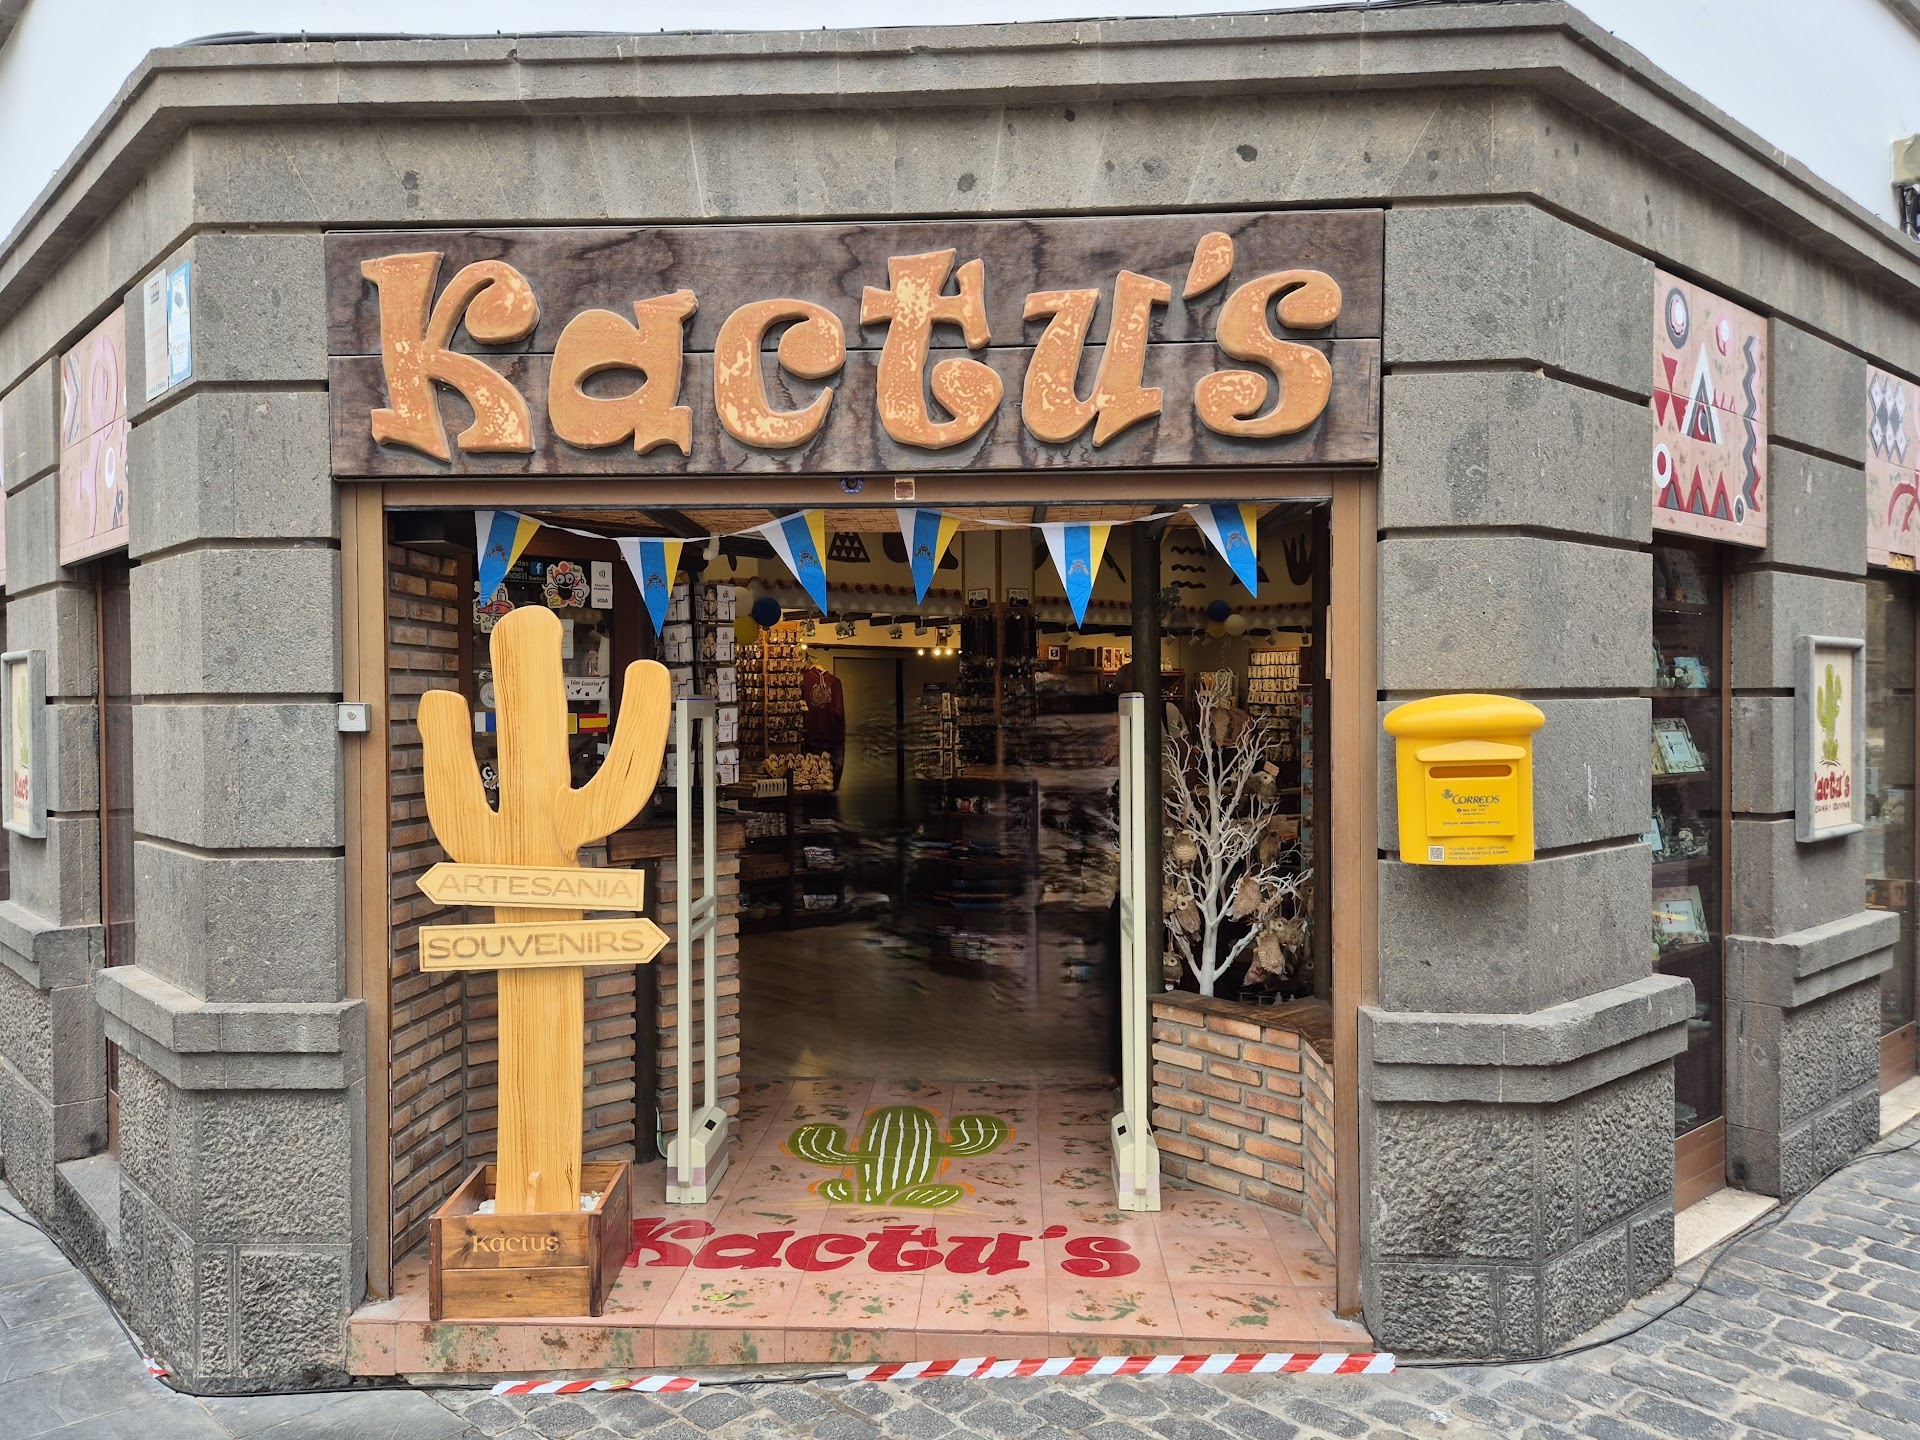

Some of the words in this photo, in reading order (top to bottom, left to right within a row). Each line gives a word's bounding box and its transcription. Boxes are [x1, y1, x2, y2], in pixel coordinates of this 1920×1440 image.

[361, 232, 1343, 463] Kactu's
[1452, 795, 1500, 804] CORREOS
[1815, 770, 1850, 801] actu's
[436, 873, 634, 900] ARTESANIA
[427, 929, 646, 960] SOUVENIRS
[472, 1235, 560, 1253] Kactus
[622, 1217, 1141, 1277] Kactu's
